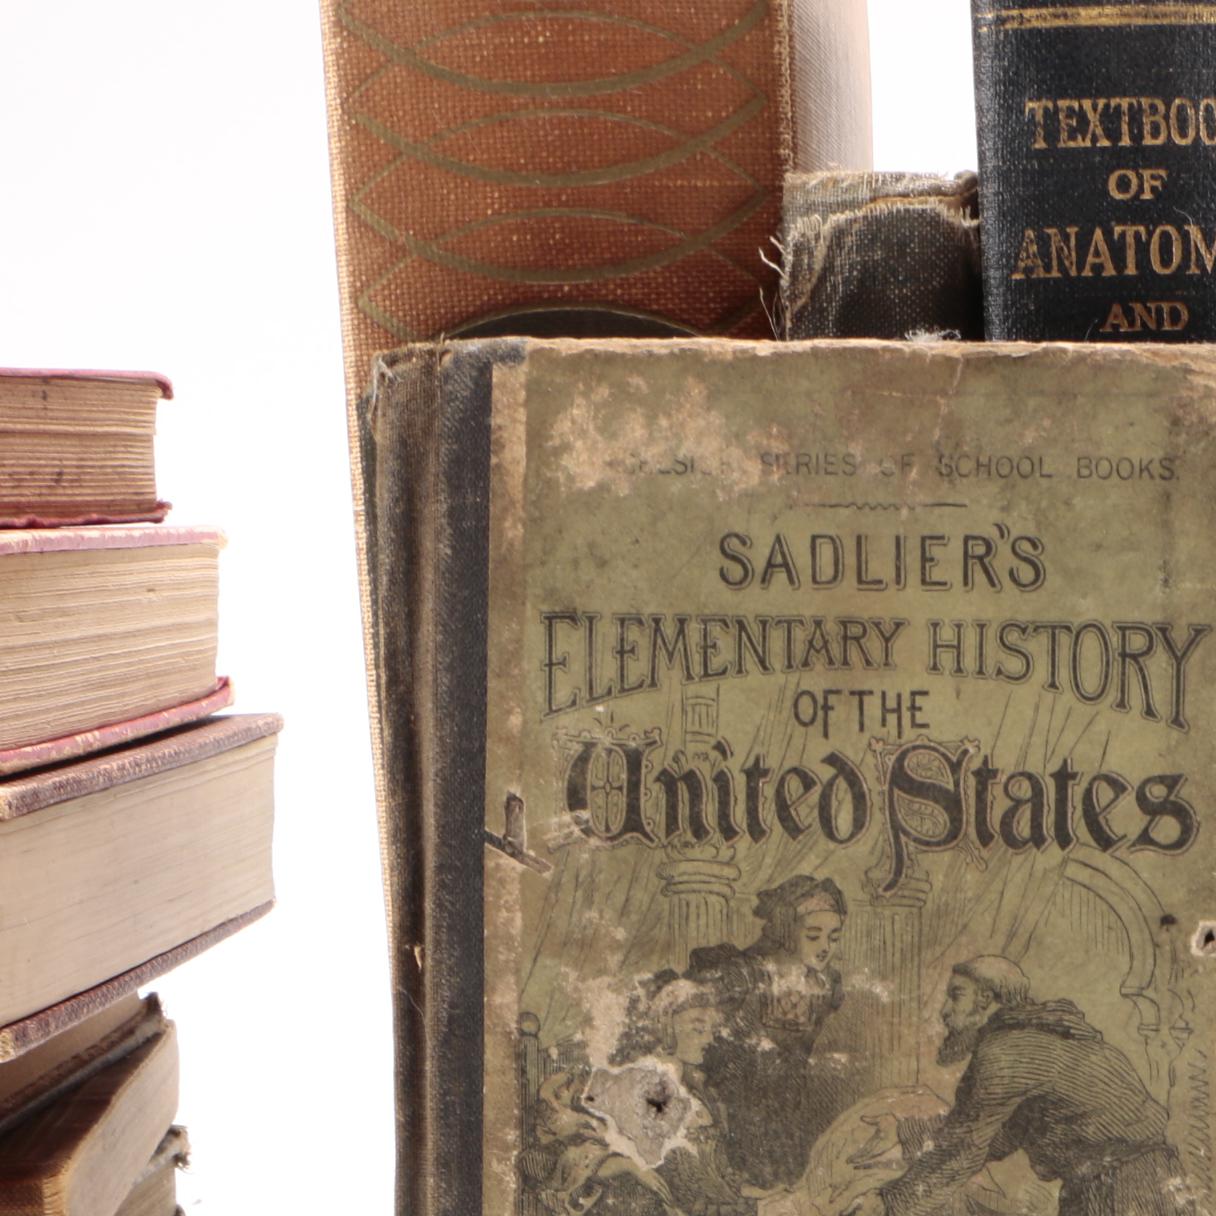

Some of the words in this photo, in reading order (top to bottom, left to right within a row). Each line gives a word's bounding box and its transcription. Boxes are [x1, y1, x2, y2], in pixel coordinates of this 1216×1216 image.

[1108, 169, 1168, 200] OF
[1100, 302, 1189, 332] AND
[718, 521, 1046, 591] SADLIER'S
[539, 611, 909, 720] ELEMENTARY
[927, 618, 1213, 733] HISTORY
[553, 728, 873, 848] United
[870, 737, 1201, 865] States
